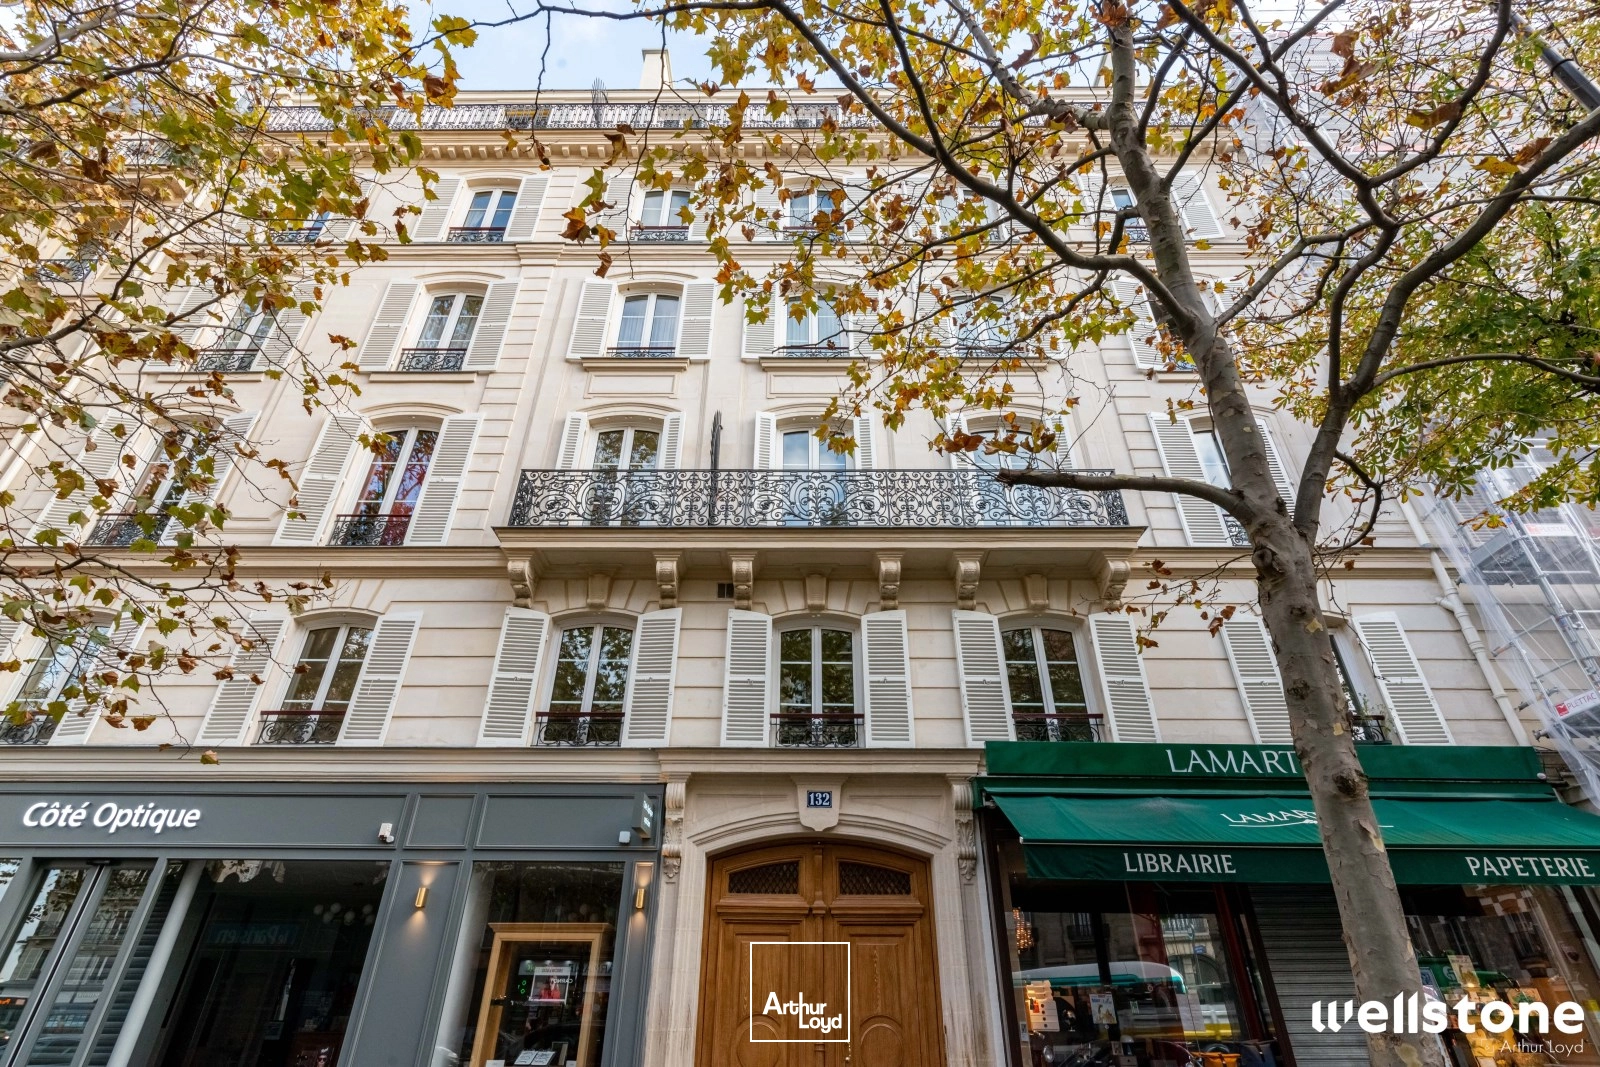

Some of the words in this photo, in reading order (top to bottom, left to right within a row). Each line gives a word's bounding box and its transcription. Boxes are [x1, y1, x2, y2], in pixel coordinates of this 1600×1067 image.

[1166, 749, 1298, 774] LAMART
[809, 793, 830, 806] 132
[22, 801, 90, 828] Côté
[92, 801, 202, 834] Optique
[1123, 853, 1237, 874] LIBRAIRIE
[1465, 856, 1596, 877] PAPETERIE
